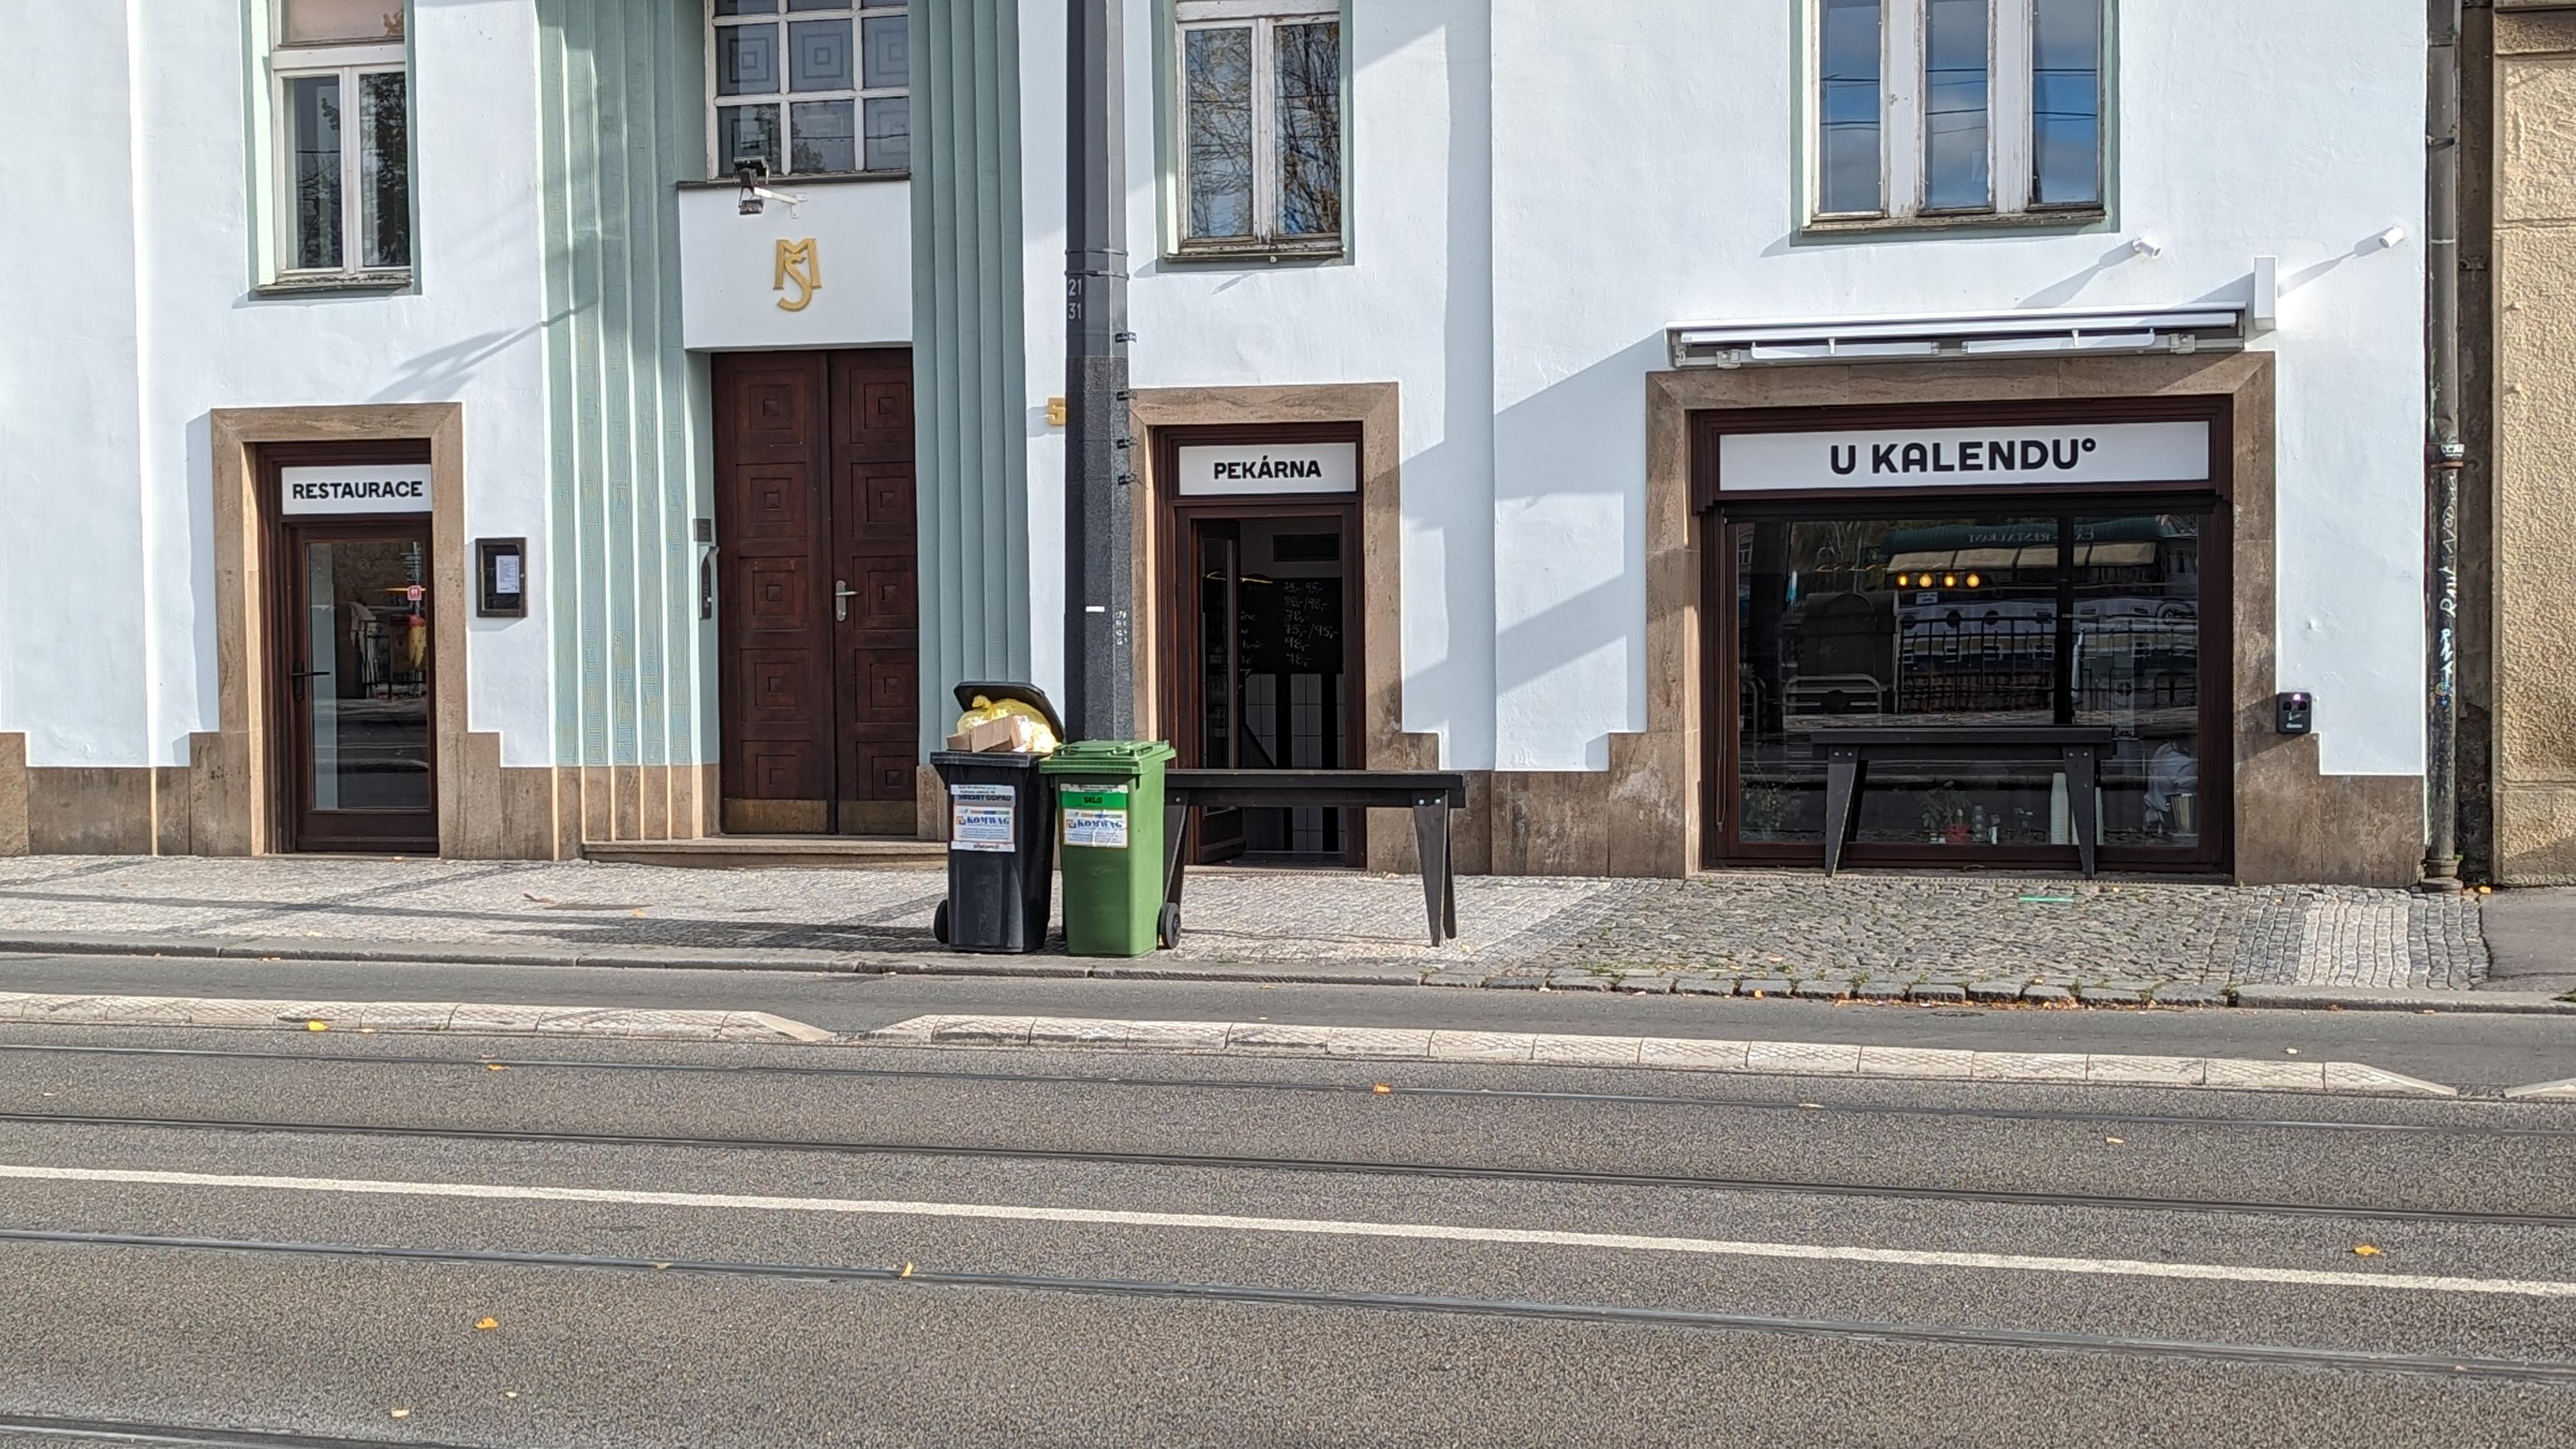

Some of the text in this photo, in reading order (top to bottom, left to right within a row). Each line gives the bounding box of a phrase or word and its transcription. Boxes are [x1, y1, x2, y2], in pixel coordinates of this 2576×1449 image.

[1068, 278, 1082, 296] 21
[1068, 303, 1082, 320] 31
[1214, 455, 1322, 480] PEKÁRNA
[1830, 444, 1856, 475] U
[292, 480, 423, 500] RESTAURACE
[967, 816, 1010, 825] KOMWAG
